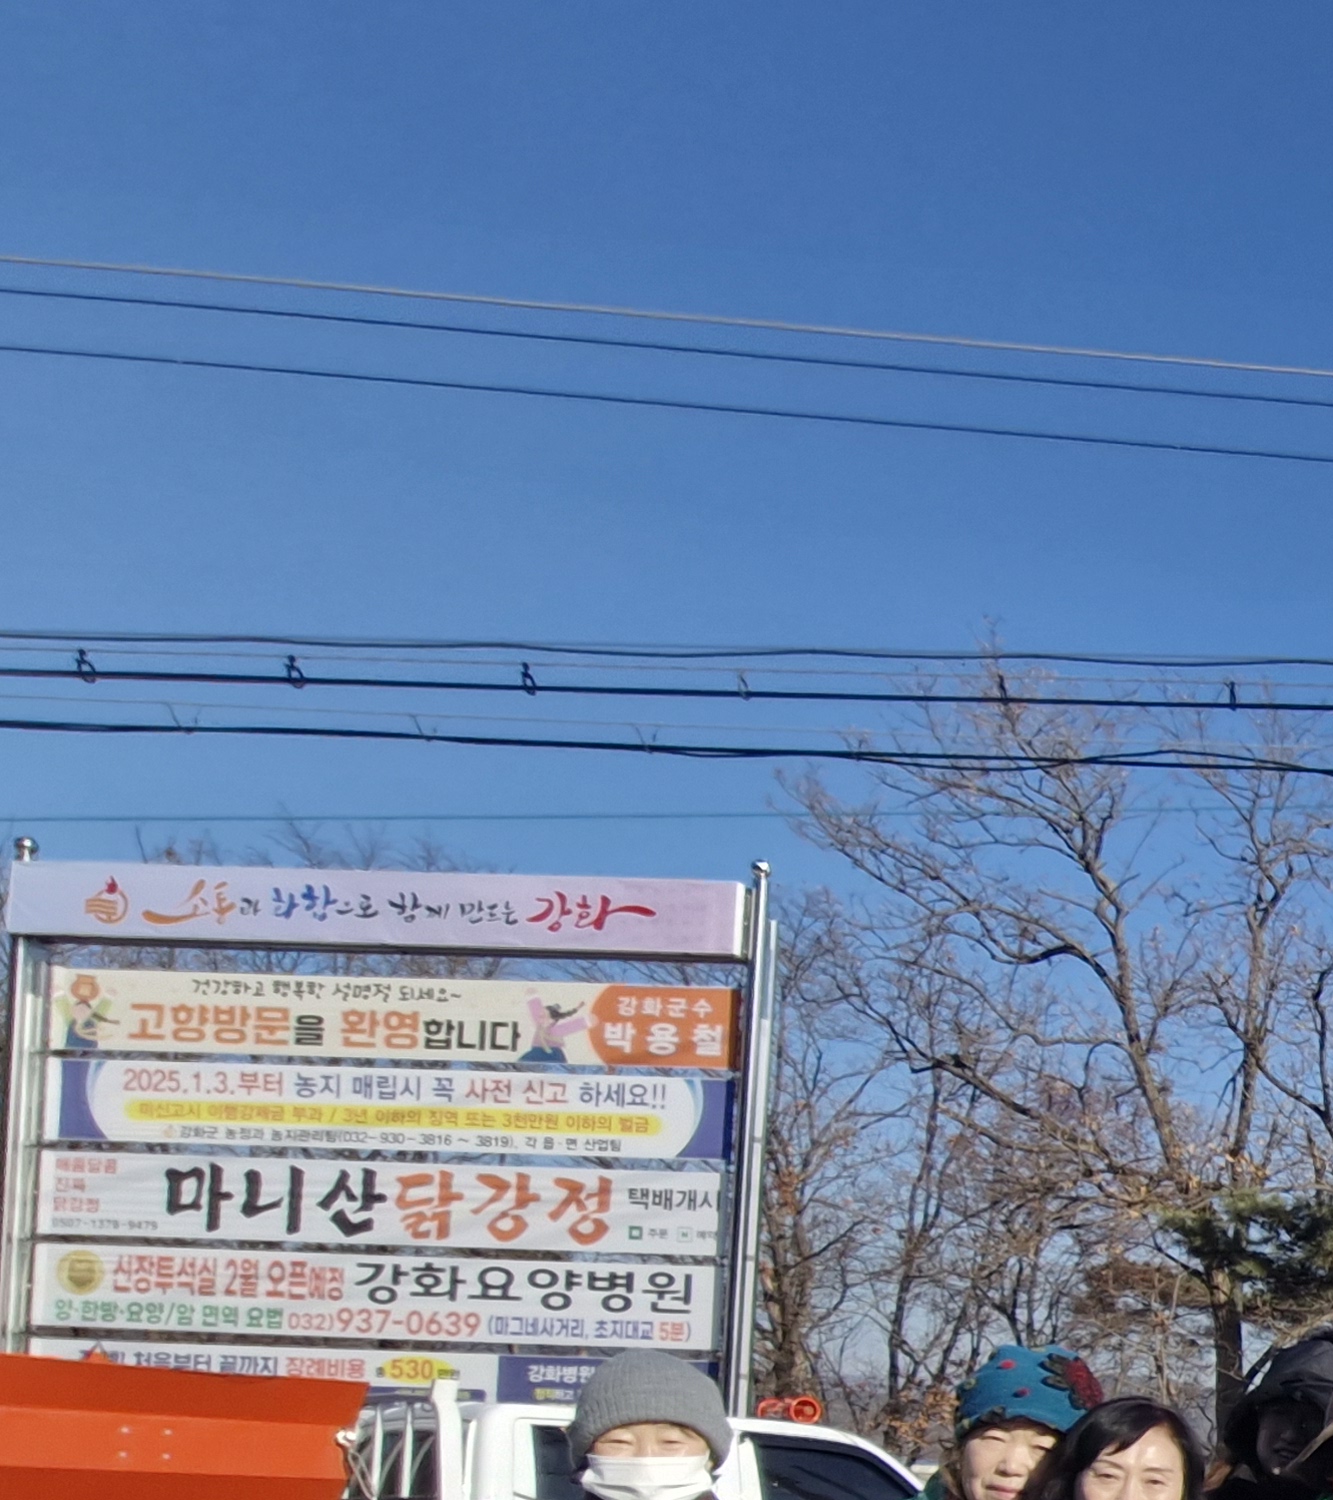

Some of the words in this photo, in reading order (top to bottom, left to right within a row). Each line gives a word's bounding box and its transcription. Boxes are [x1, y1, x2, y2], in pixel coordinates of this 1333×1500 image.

[526, 891, 656, 932] 강화
[192, 979, 265, 997] 건강하고
[272, 980, 325, 1000] 행복한
[332, 982, 391, 1002] 설명절
[617, 996, 713, 1018] 강화군수
[128, 1003, 325, 1047] 고향방문을
[340, 1007, 521, 1051] 환영합니다
[122, 1068, 283, 1096] 2025.1.3.부터
[295, 1072, 340, 1099] 농지
[352, 1074, 421, 1101] 매립시
[432, 1077, 455, 1100] 꼭
[465, 1078, 511, 1103] 사전
[523, 1080, 569, 1105] 신고
[579, 1082, 667, 1109] 하세요!!
[465, 1112, 496, 1127] 또는
[502, 1113, 558, 1130] 3천만원
[567, 1114, 611, 1131] 이하의
[628, 1188, 720, 1211] 택배개시
[224, 1258, 259, 1298] 2월
[354, 1262, 693, 1314] 강화요양병원
[202, 1305, 239, 1327] 면역
[246, 1307, 283, 1330] 요법
[595, 1319, 654, 1341] 초지대교
[659, 1321, 691, 1343] 5분)
[391, 1359, 432, 1379] 530
